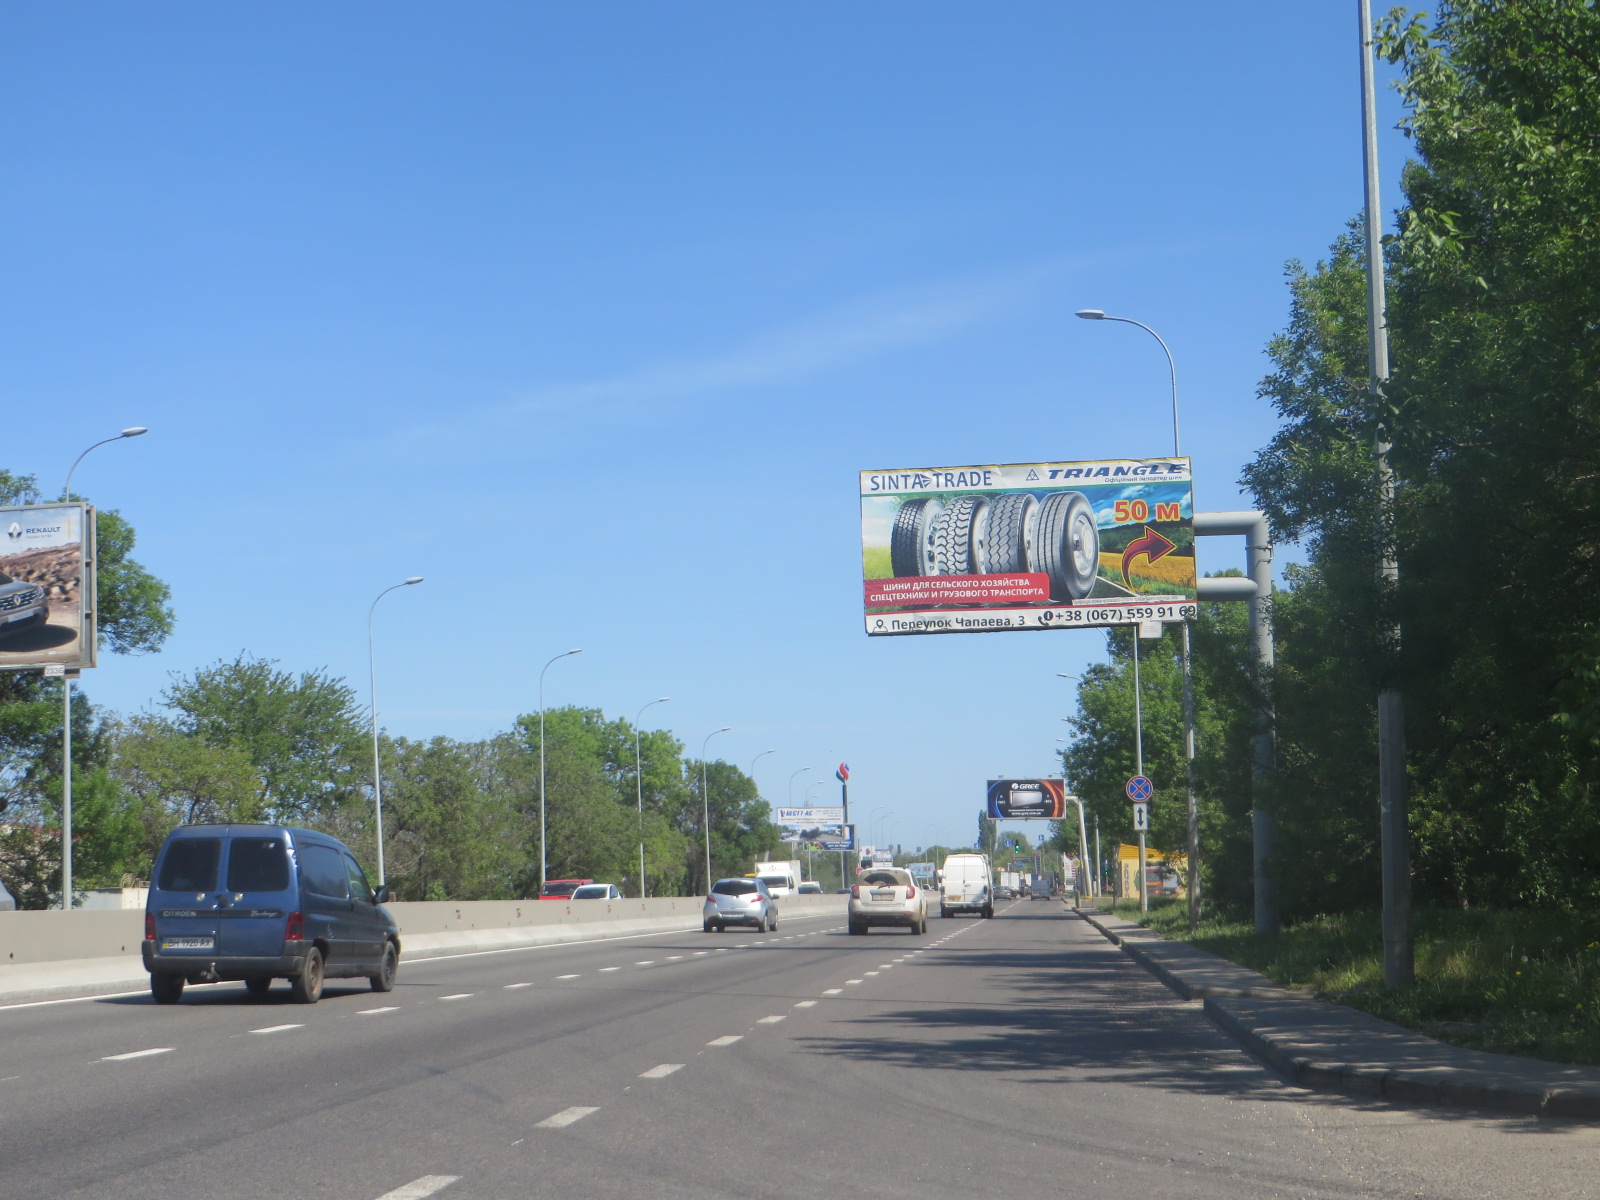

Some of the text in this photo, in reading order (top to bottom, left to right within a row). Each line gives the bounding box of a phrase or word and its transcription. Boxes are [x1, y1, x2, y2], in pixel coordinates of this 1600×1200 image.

[1048, 463, 1186, 480] TRIANGLE
[1104, 476, 1138, 484] Офіційний
[1138, 475, 1168, 484] імпортер
[870, 470, 993, 491] SINTA TRADE
[1114, 500, 1148, 523] 50
[26, 526, 61, 534] RENAULT
[883, 578, 1030, 591] ШИНИ ДЛЯ СЕЛЬСКОГО ХОЗЯЙСТВА
[870, 591, 930, 602] СПЕЦТЕХНИКИ
[940, 589, 988, 599] ГРУЗОВОГО
[990, 587, 1044, 597] ТРАНСПОРТА
[1055, 610, 1082, 621] +38
[1086, 608, 1123, 622] (067)
[1126, 608, 1153, 619] 559
[1157, 606, 1174, 617] 91
[891, 615, 1026, 632] Переулок Чапаева, 3
